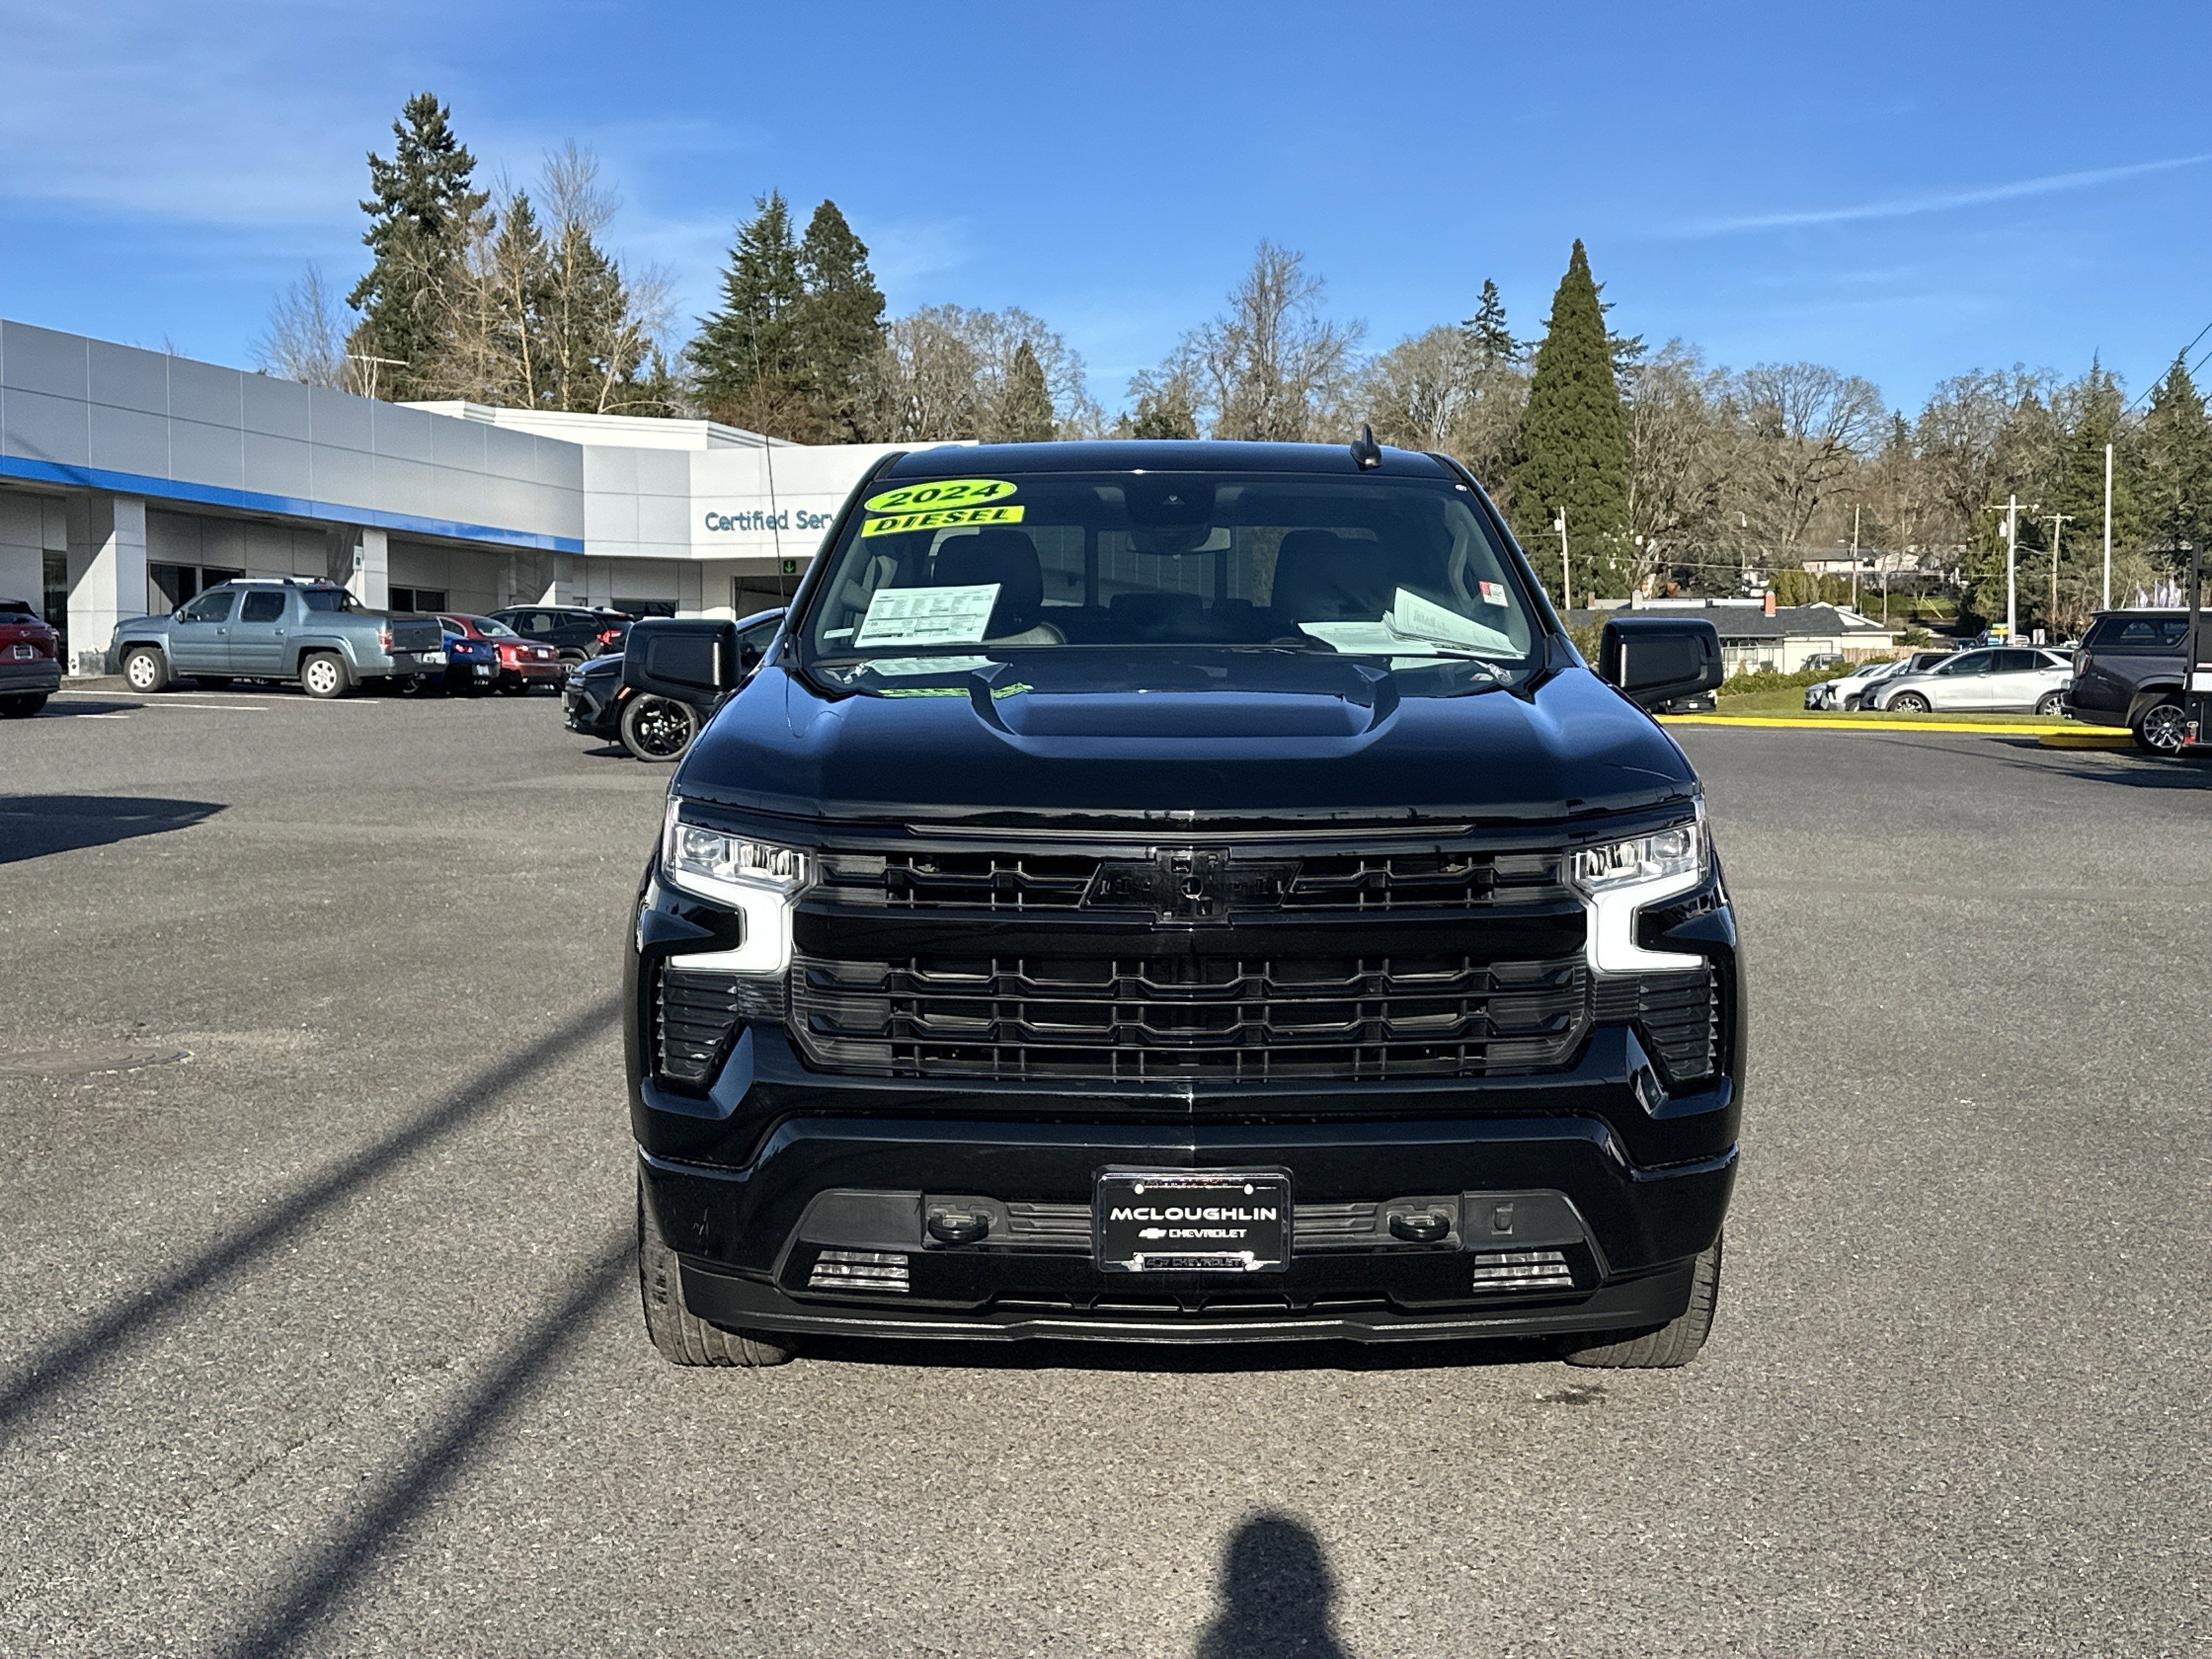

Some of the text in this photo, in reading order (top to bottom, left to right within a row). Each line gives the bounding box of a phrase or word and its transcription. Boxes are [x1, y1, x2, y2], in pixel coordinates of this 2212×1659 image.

[879, 483, 1001, 510] 2024
[705, 509, 789, 532] Certified
[873, 509, 1009, 532] DIESEL
[1110, 1207, 1277, 1221] MCLOUGHLIN
[1169, 1228, 1248, 1238] CHEVROLET
